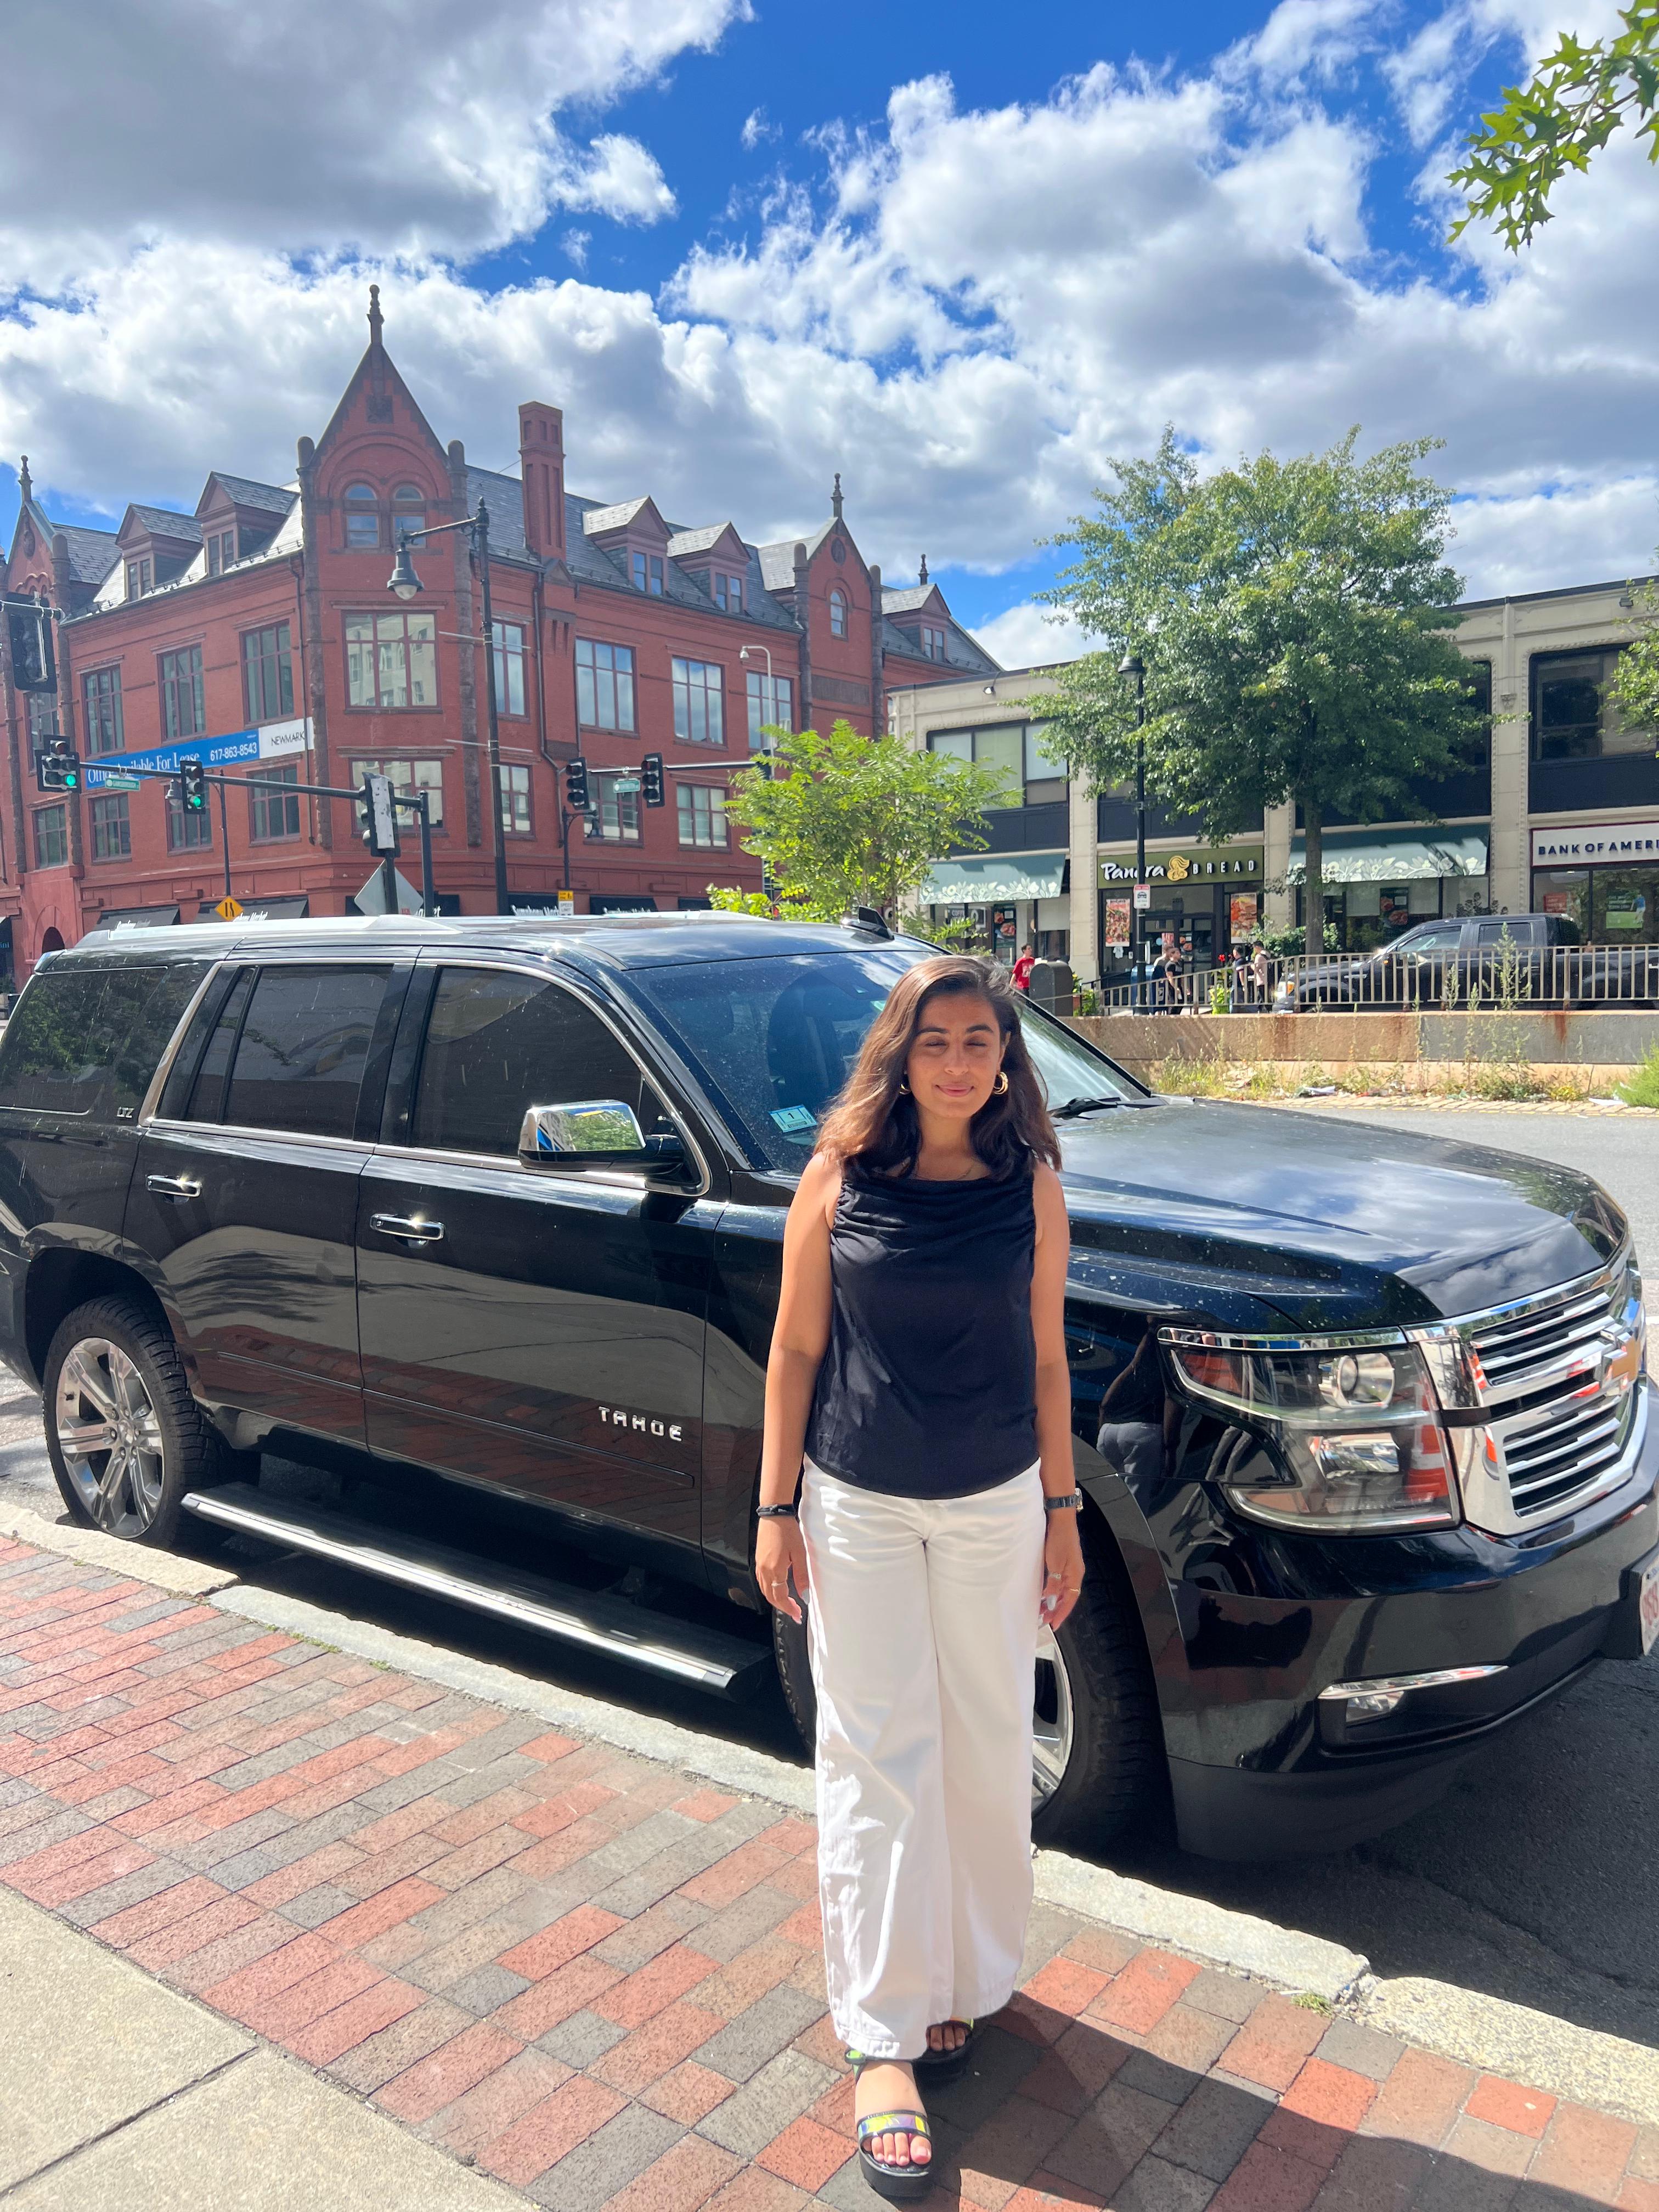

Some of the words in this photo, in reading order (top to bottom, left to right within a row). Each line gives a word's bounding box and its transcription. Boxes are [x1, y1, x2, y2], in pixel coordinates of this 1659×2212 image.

[272, 731, 306, 746] NEWMARK
[156, 754, 172, 771] For
[211, 742, 257, 761] 617-863-8543
[1539, 844, 1580, 855] BANK
[1585, 843, 1604, 853] OF
[1101, 862, 1164, 881] Panra
[1193, 860, 1255, 875] BREAD
[117, 1107, 134, 1118] LTZ
[599, 1406, 682, 1441] TAHOE
